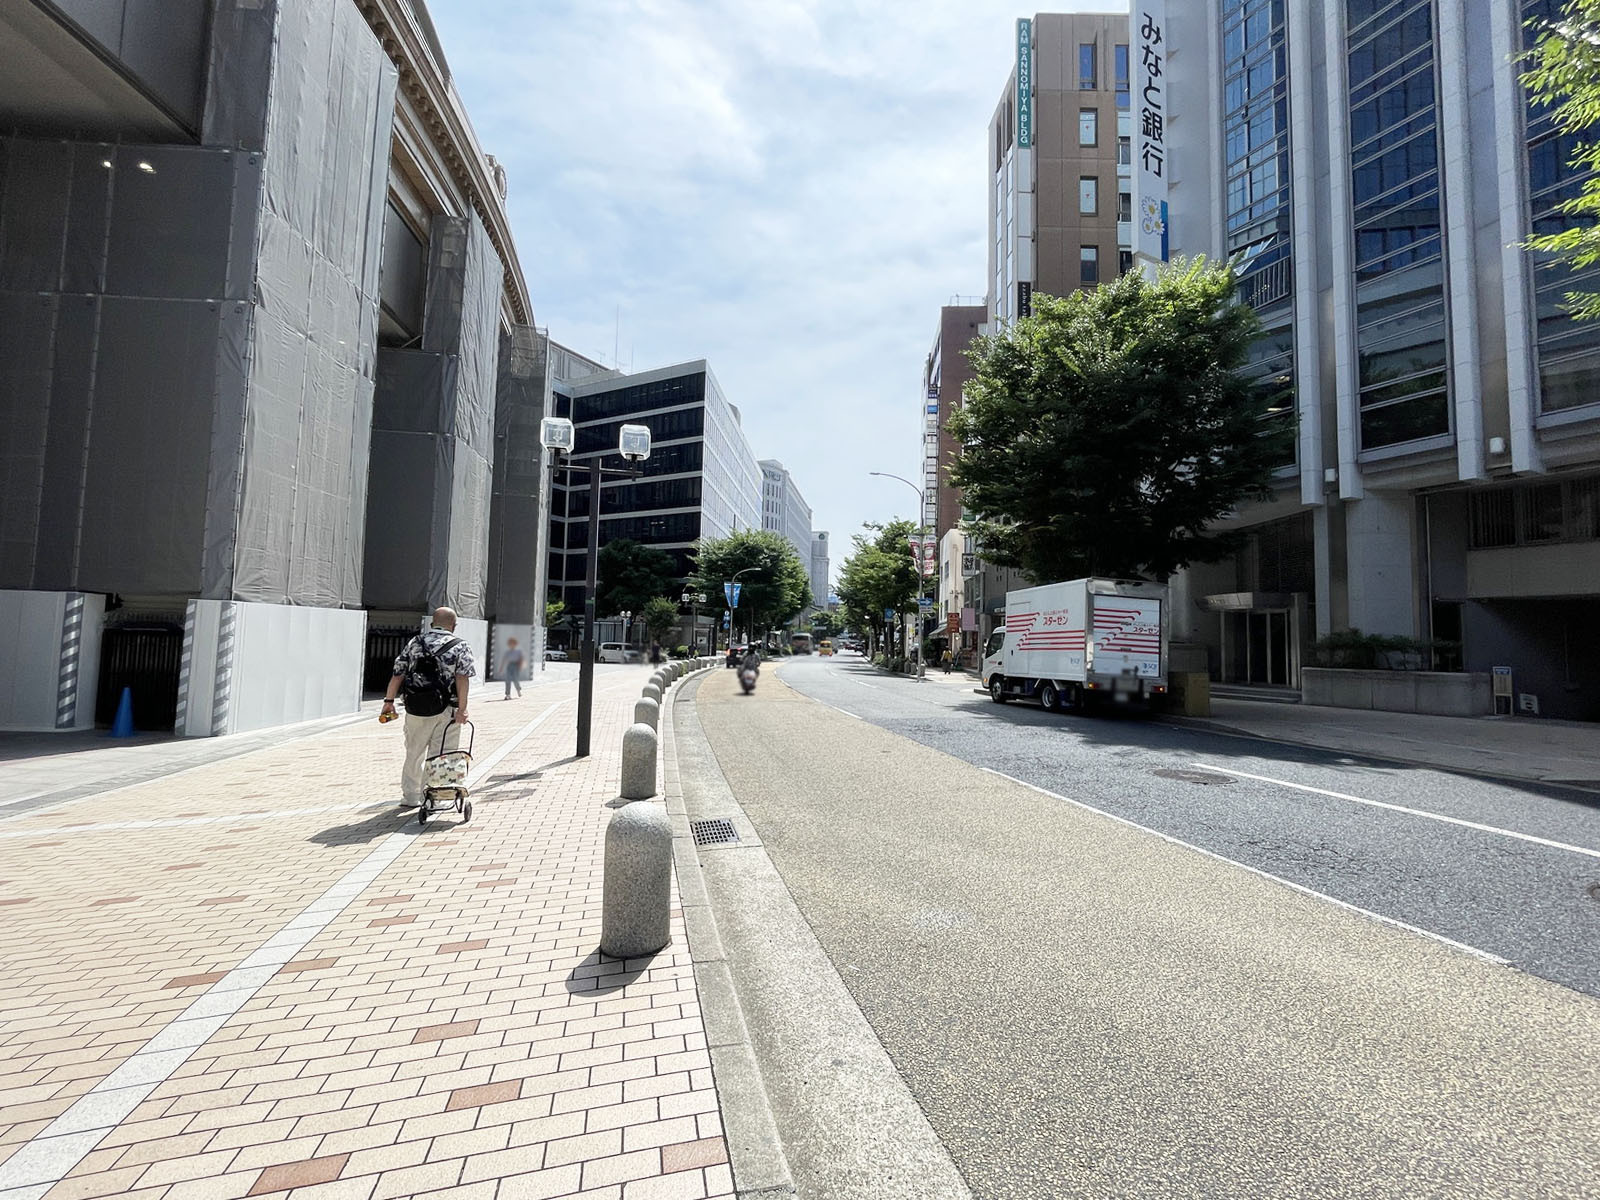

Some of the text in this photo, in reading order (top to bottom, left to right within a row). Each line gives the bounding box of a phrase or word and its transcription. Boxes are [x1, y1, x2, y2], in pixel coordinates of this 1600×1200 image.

[1020, 46, 1028, 112] SANNOMIYA
[1141, 12, 1163, 178] みなと銀行
[1020, 114, 1028, 144] BLDG
[1043, 616, 1069, 626] スターゼン
[1133, 626, 1160, 635] スターゼン
